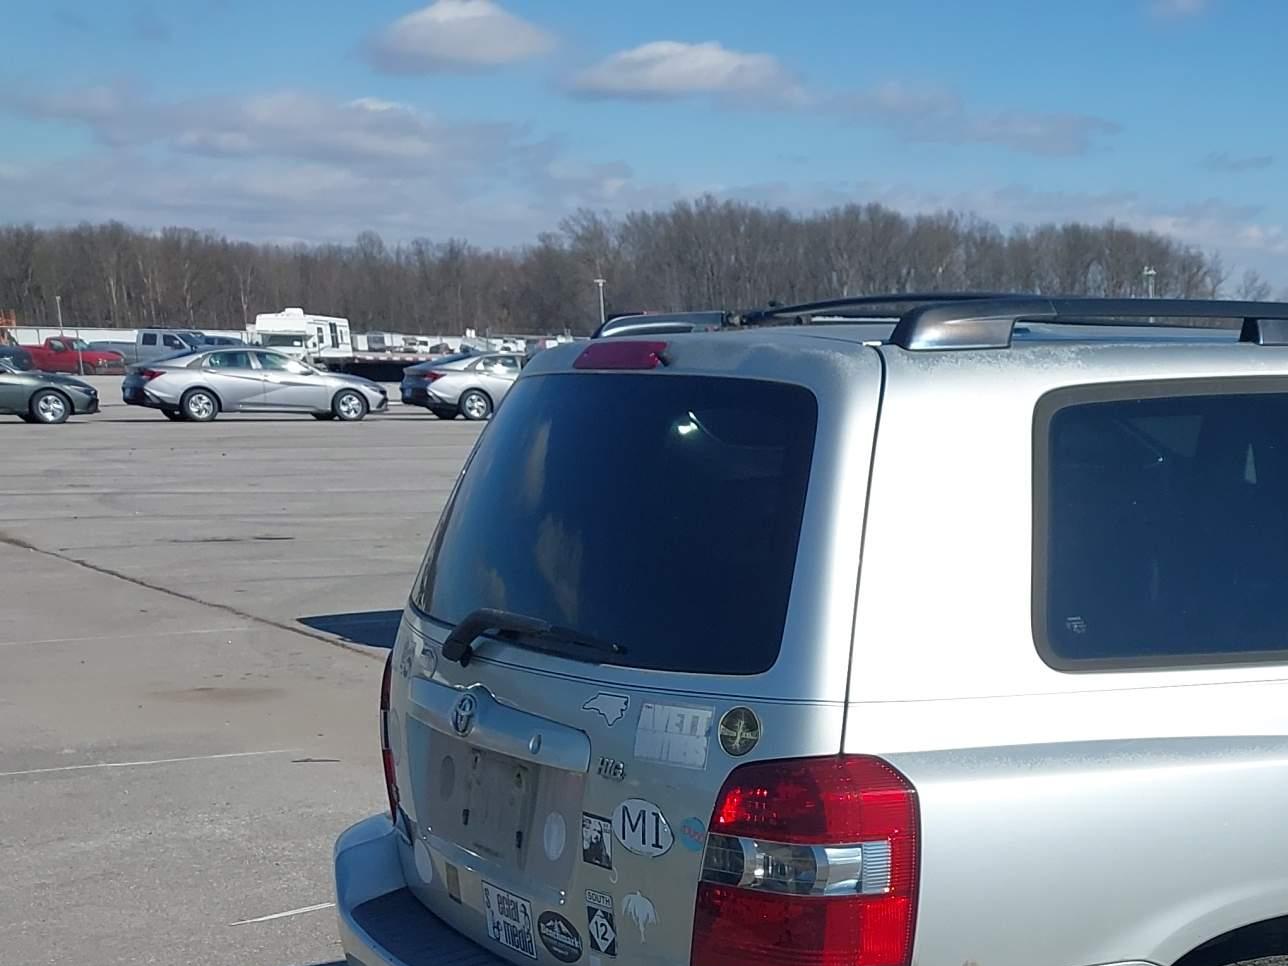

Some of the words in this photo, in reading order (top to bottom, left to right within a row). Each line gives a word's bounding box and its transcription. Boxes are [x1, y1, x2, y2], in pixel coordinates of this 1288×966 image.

[621, 805, 663, 850] MI
[586, 891, 612, 906] SOUTH
[595, 919, 609, 941] 12
